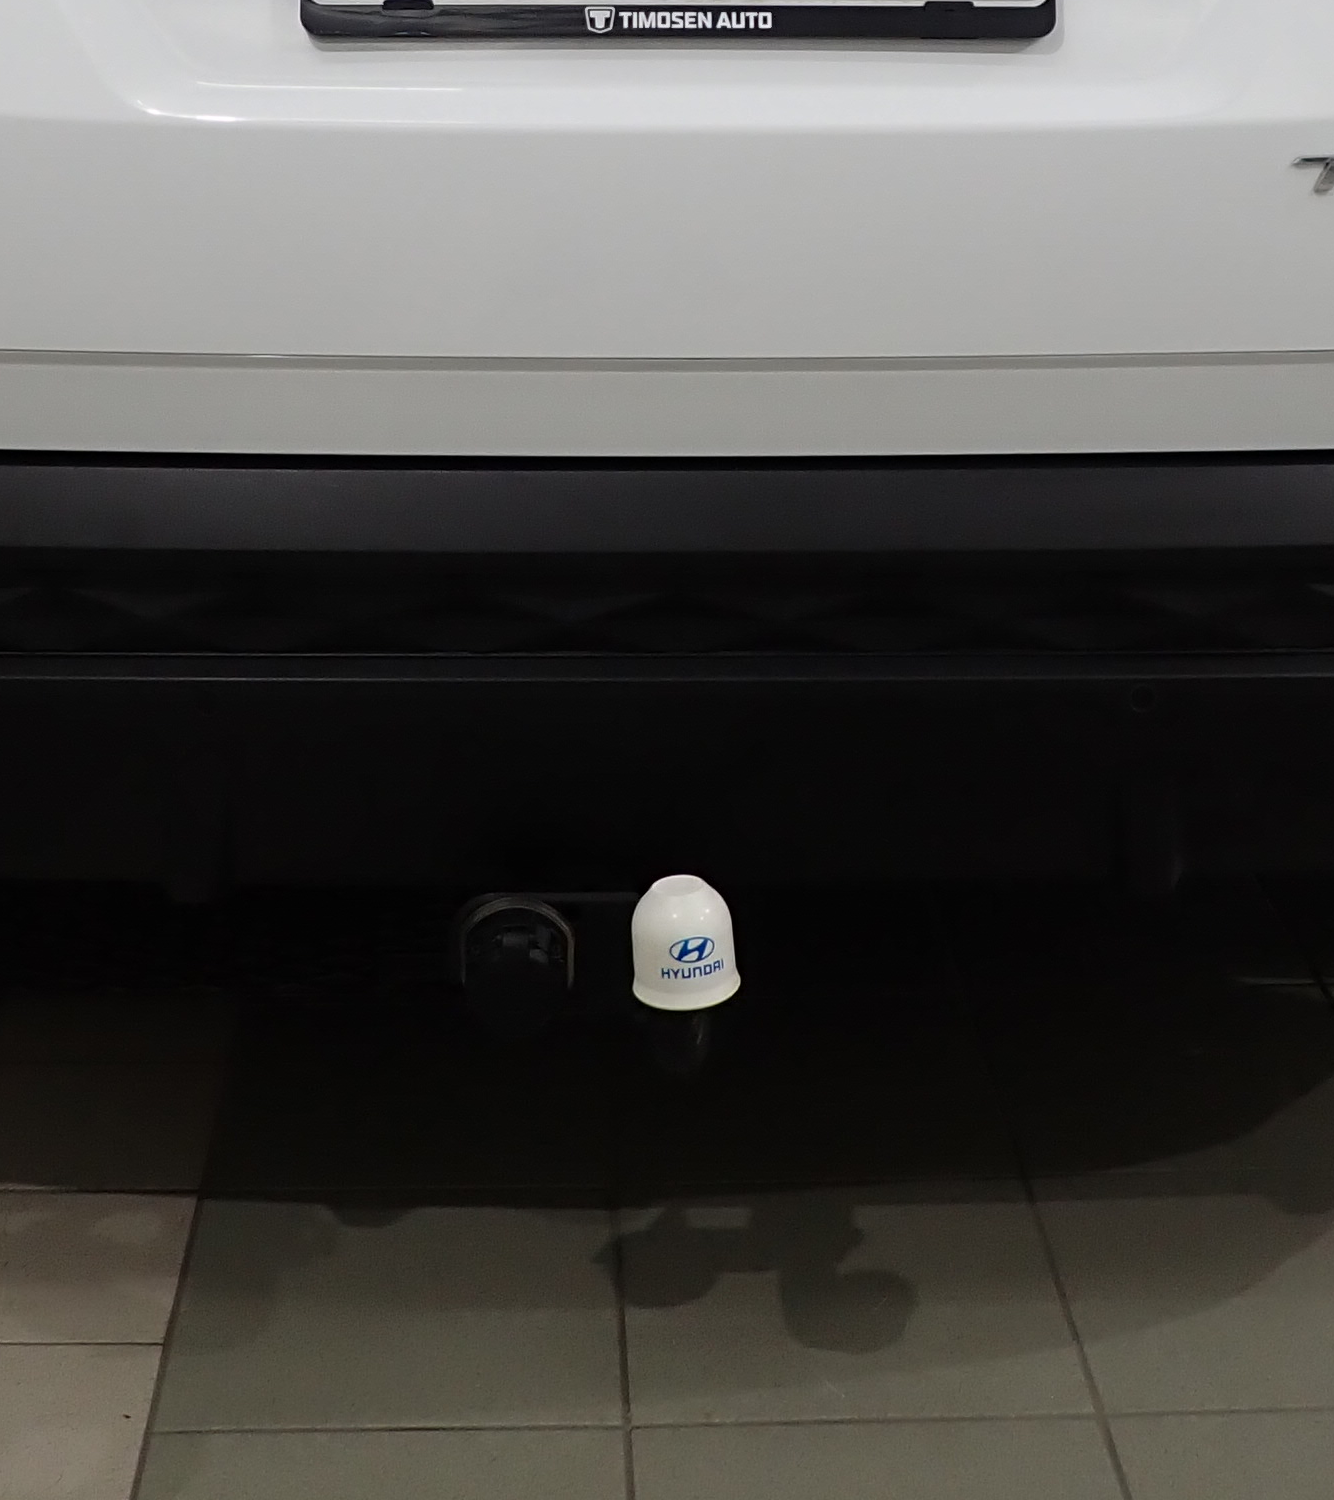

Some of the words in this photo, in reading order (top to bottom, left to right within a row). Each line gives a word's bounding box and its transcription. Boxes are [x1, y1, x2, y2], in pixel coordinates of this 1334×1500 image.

[619, 11, 713, 29] TIMOSEN
[716, 11, 773, 29] AUTO
[661, 958, 724, 979] HYUNDAI
